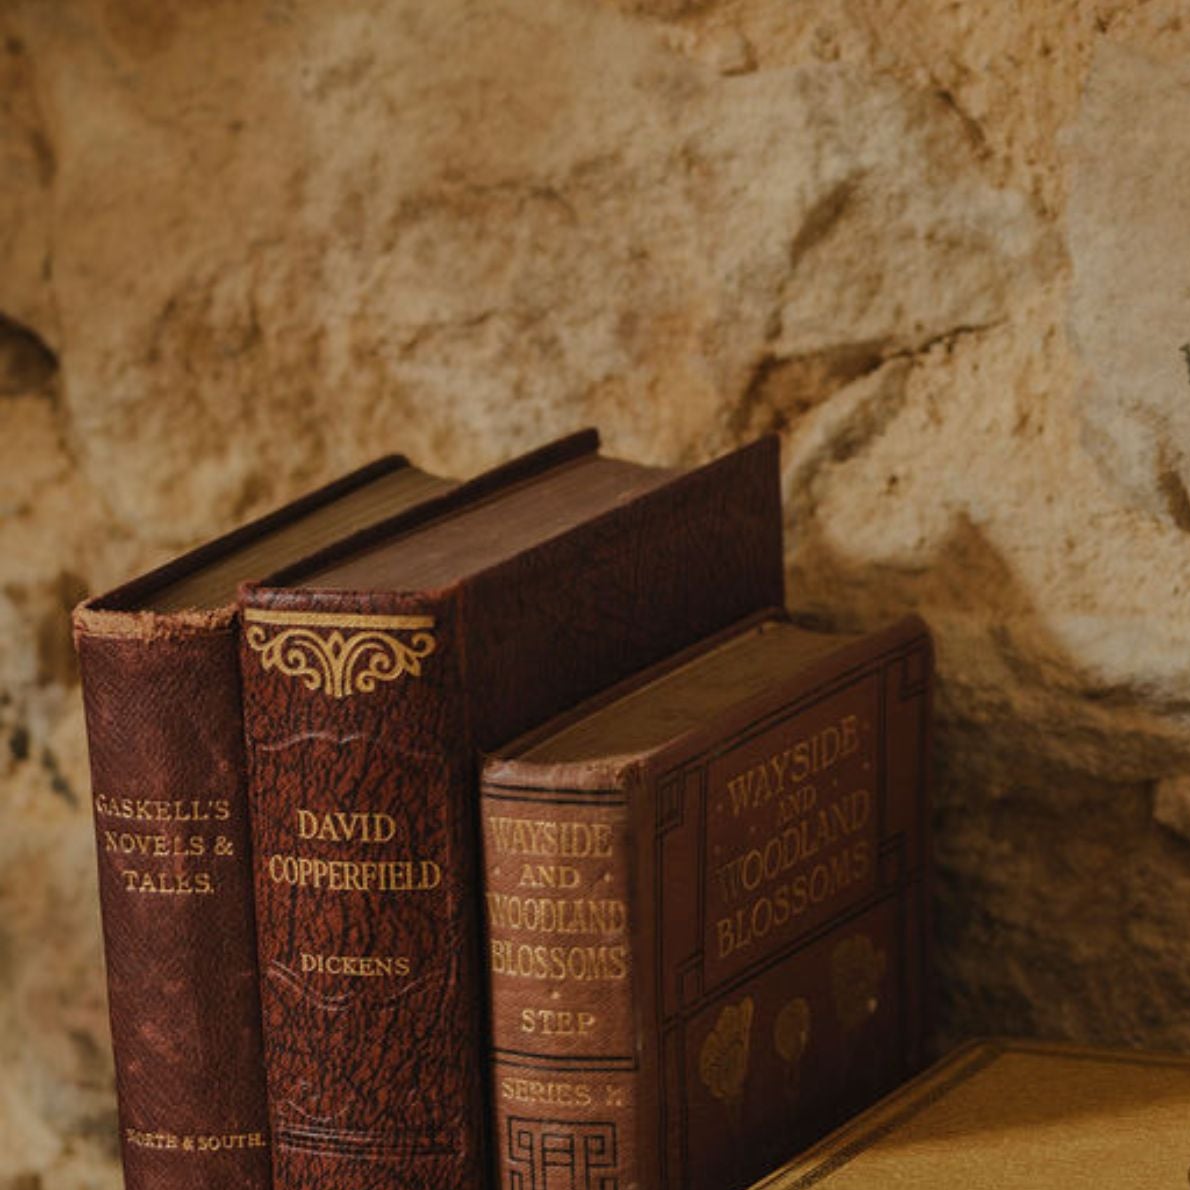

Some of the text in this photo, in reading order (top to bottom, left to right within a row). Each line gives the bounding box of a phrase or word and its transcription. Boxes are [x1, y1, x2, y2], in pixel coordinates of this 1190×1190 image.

[726, 714, 858, 817] WAYSIDE
[96, 794, 231, 821] GASKELL'S
[104, 830, 234, 857] NOVELS &
[297, 809, 397, 844] DAVID
[489, 816, 613, 858] WAYSIDE
[715, 789, 870, 901] WOODLAND
[268, 853, 442, 892] COPPERFIELD
[519, 864, 581, 890] AND
[487, 892, 627, 935] WOODLAND
[716, 840, 869, 958] BLOSSOMS
[301, 954, 411, 978] DICKENS
[491, 938, 627, 981] BLOSSOMS
[521, 1008, 597, 1035] STEP
[502, 1078, 592, 1107] SERIES
[183, 1135, 195, 1151] &
